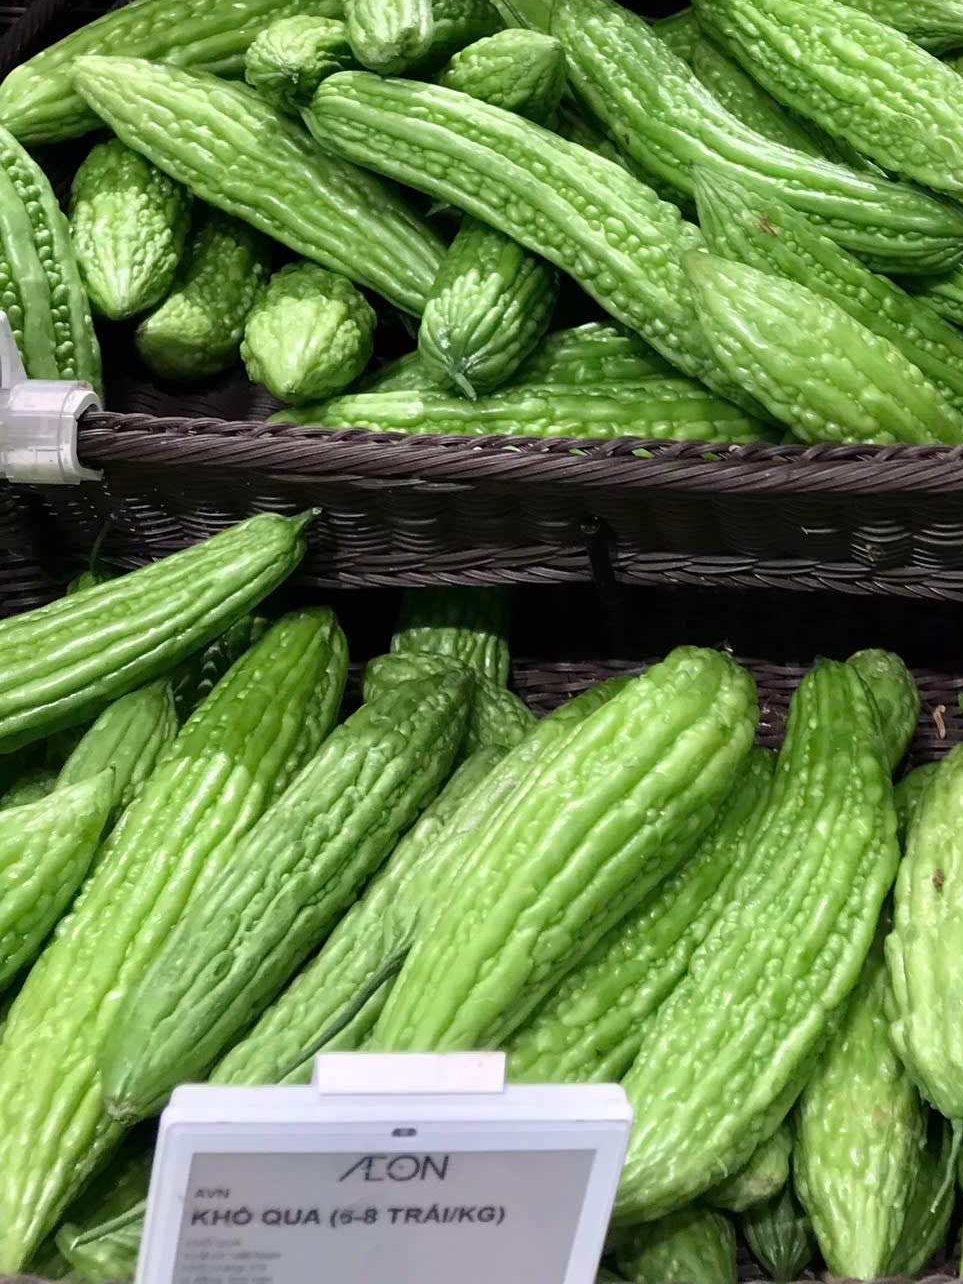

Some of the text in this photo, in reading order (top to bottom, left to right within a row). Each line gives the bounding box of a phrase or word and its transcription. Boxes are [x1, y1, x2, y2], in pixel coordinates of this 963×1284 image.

[195, 1188, 230, 1199] AVN
[261, 1208, 320, 1226] QUA
[387, 1203, 506, 1227] TRÁI/KG)
